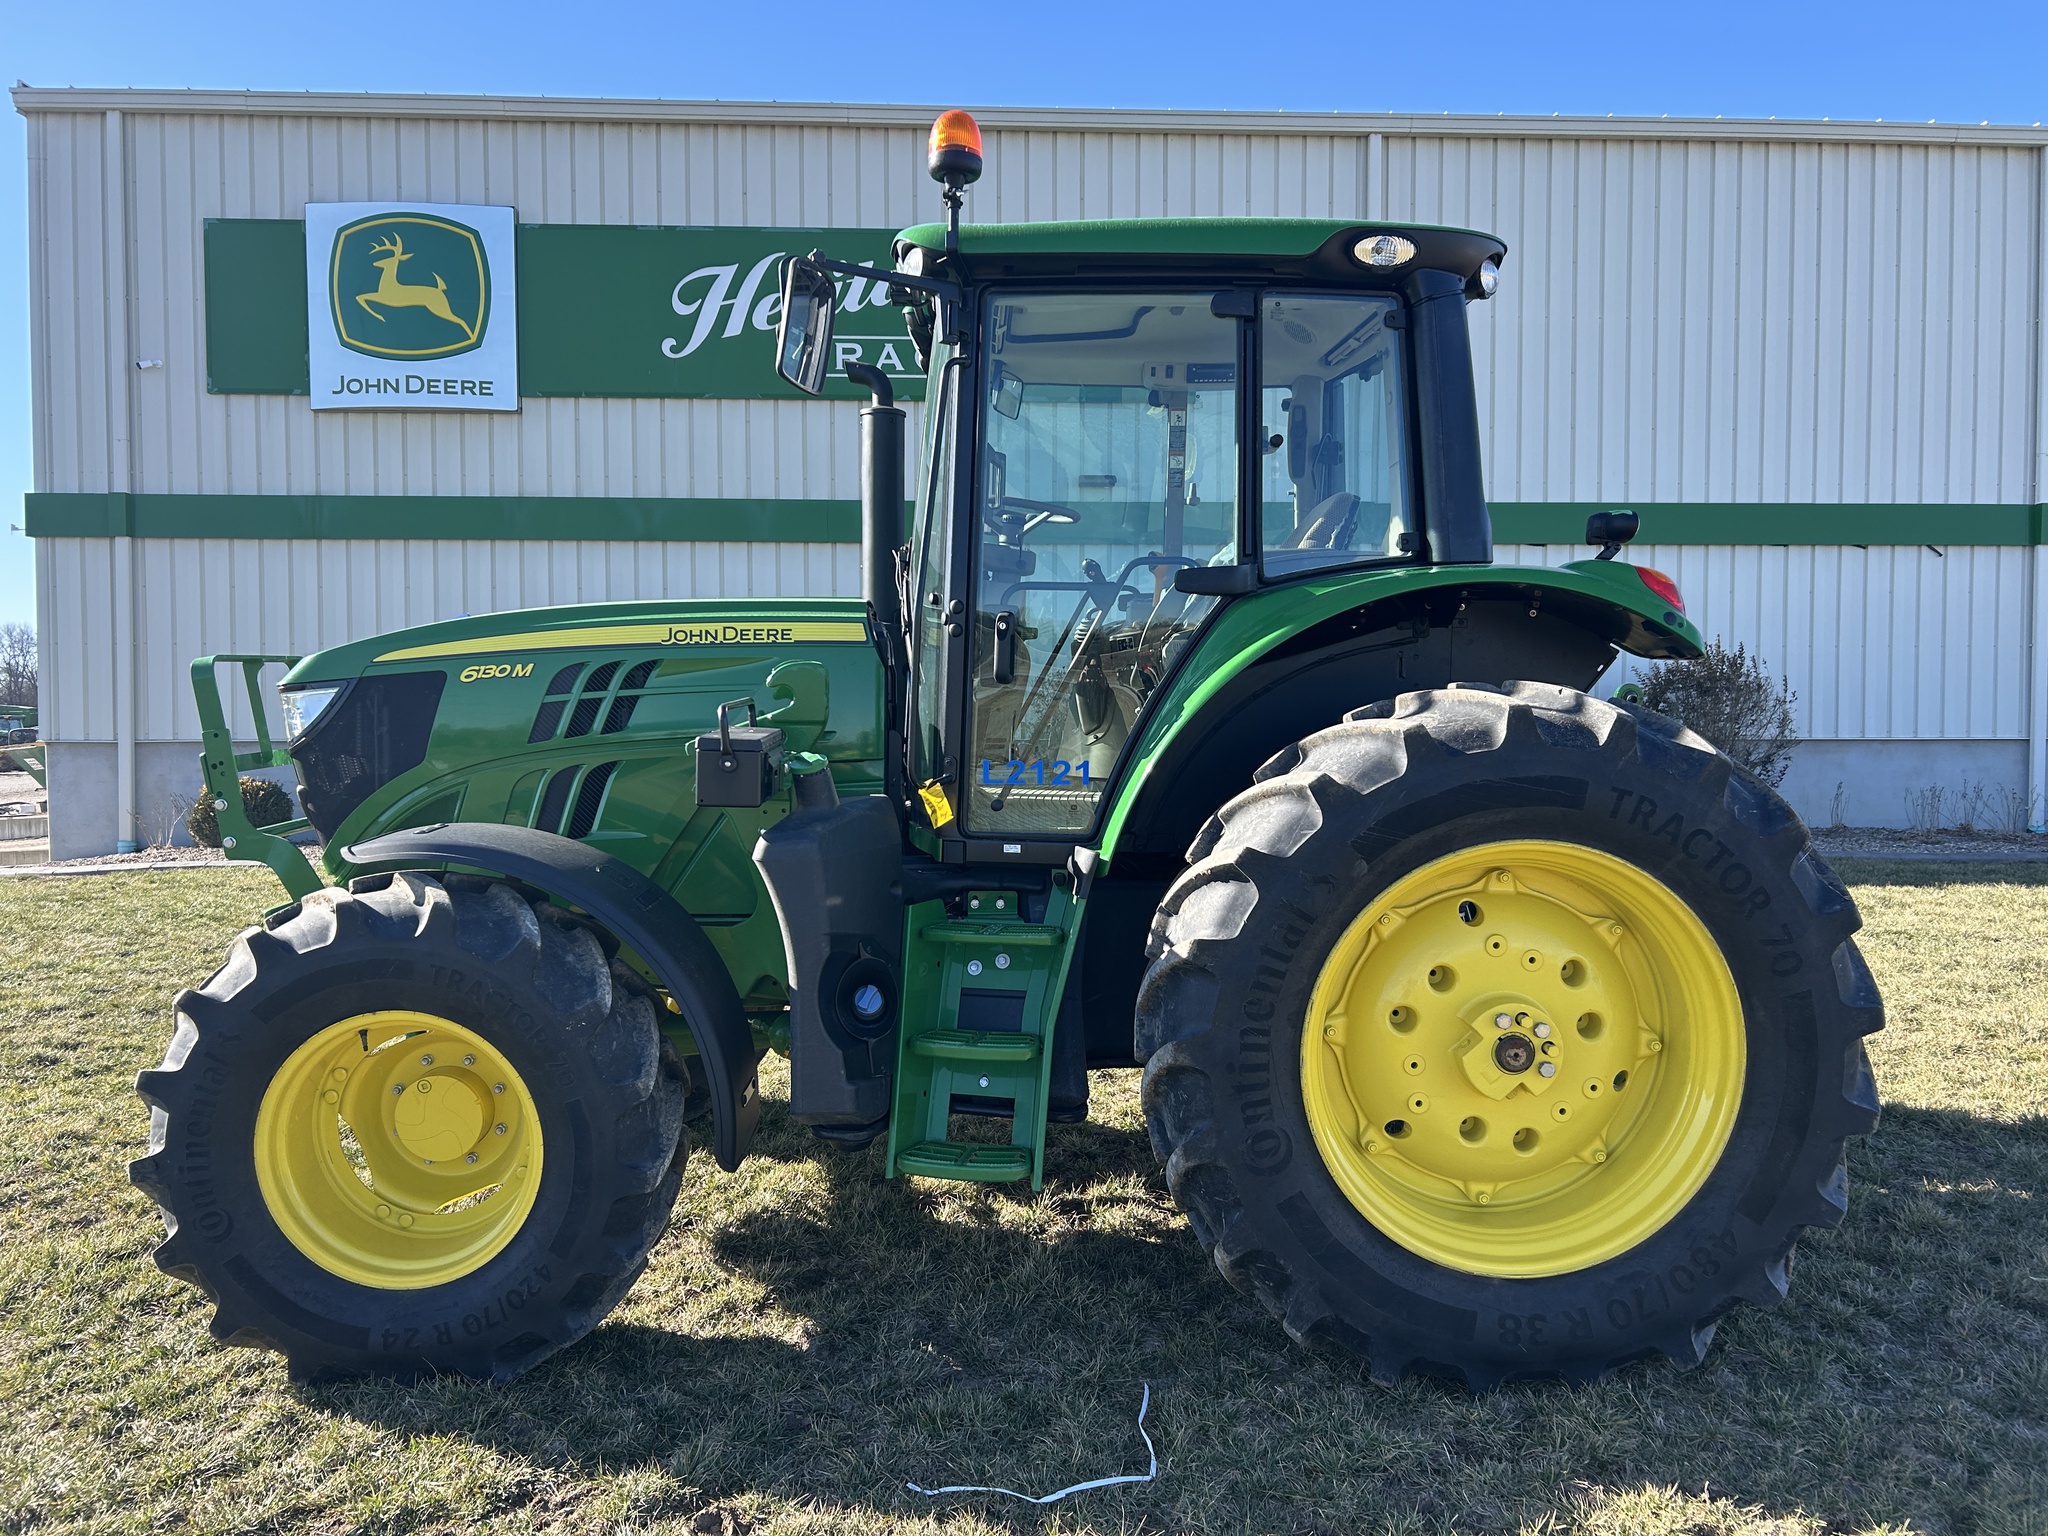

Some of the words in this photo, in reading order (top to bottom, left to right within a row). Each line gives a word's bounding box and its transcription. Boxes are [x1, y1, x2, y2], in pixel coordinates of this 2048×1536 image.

[331, 375, 400, 395] JOHN
[405, 374, 494, 397] DEERE
[660, 626, 719, 644] JOHN
[722, 625, 794, 643] DEERE
[1609, 786, 1771, 918] TRACTOR
[1758, 922, 1803, 977] 70
[545, 1051, 577, 1089] 70
[1605, 1227, 1739, 1332] 480/70
[461, 1263, 554, 1338] 420/70
[380, 1327, 421, 1351] 24
[432, 1320, 454, 1346] R
[1497, 1312, 1550, 1347] 38
[1561, 1305, 1595, 1341] R
